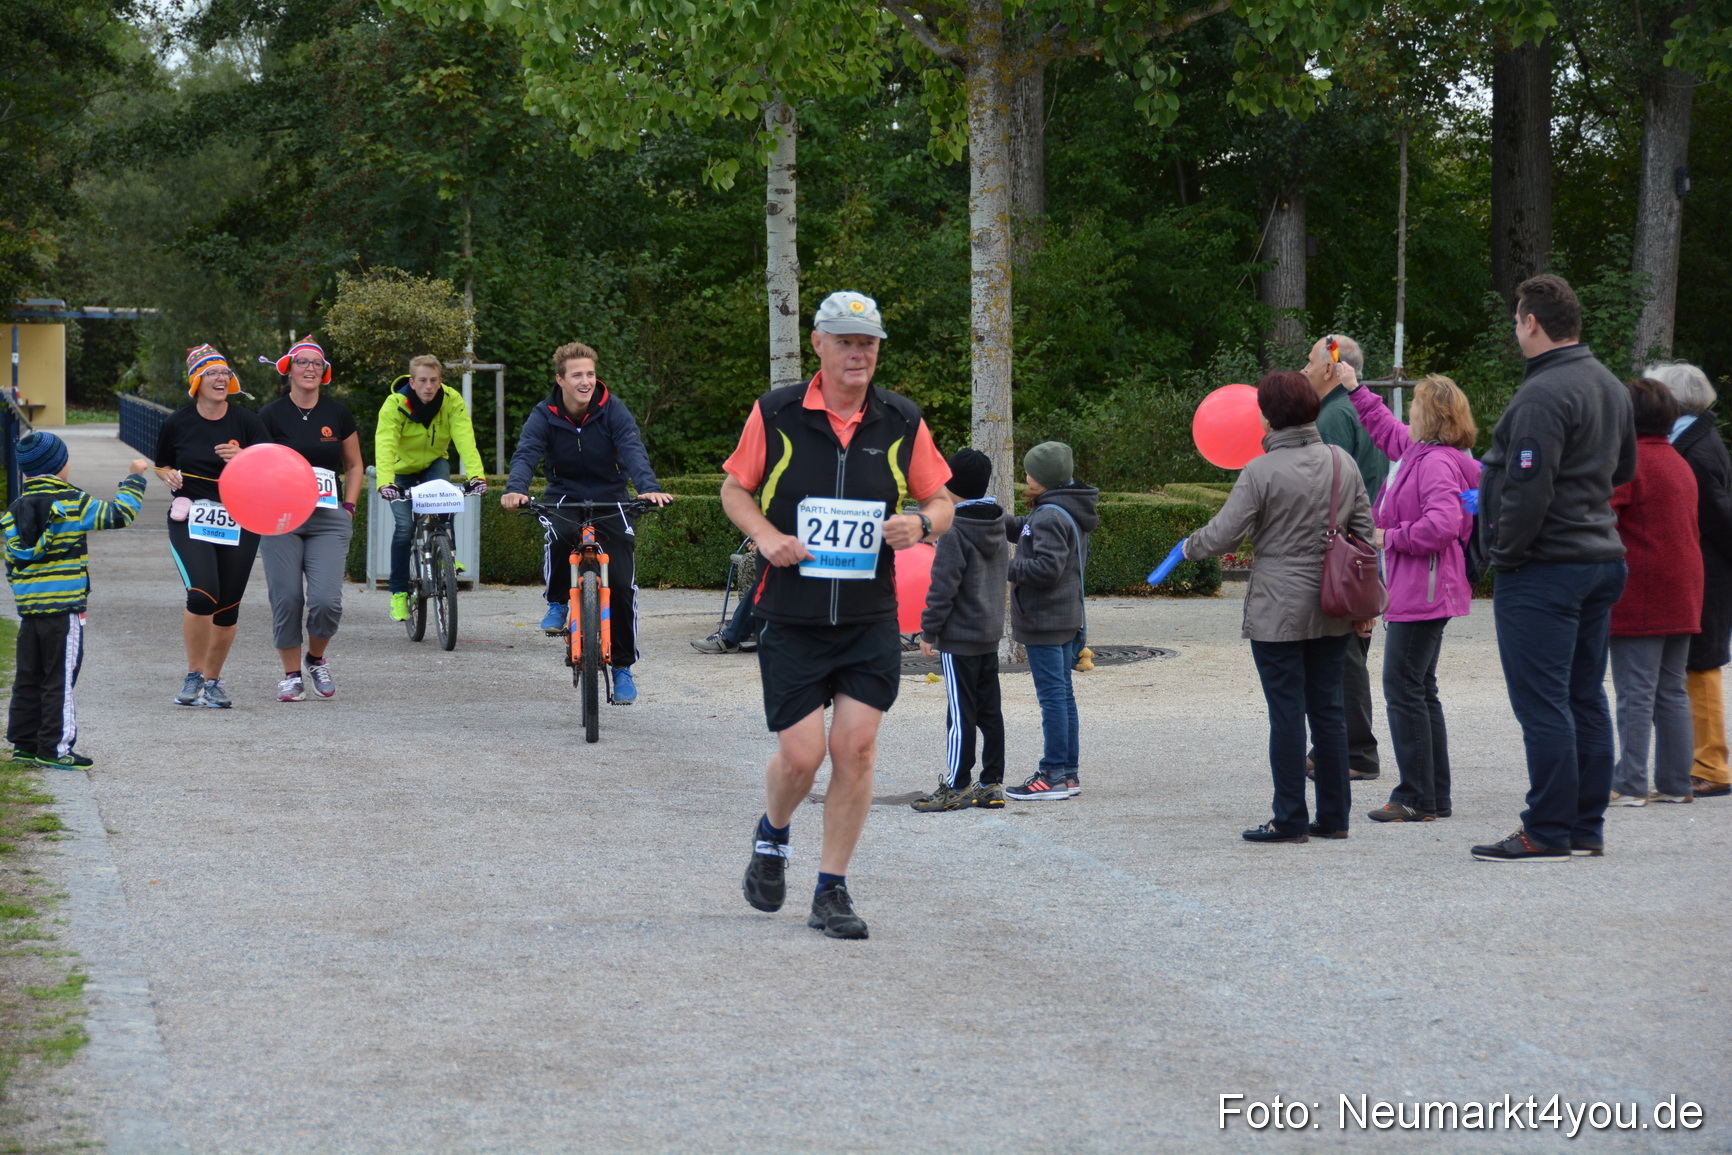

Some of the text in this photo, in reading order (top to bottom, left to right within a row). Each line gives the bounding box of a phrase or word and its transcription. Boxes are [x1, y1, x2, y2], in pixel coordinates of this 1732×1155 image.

[800, 505, 870, 517] PARTL Neumarkt
[202, 528, 226, 538] Sandra
[807, 517, 875, 549] 2478
[820, 555, 856, 567] Hubert
